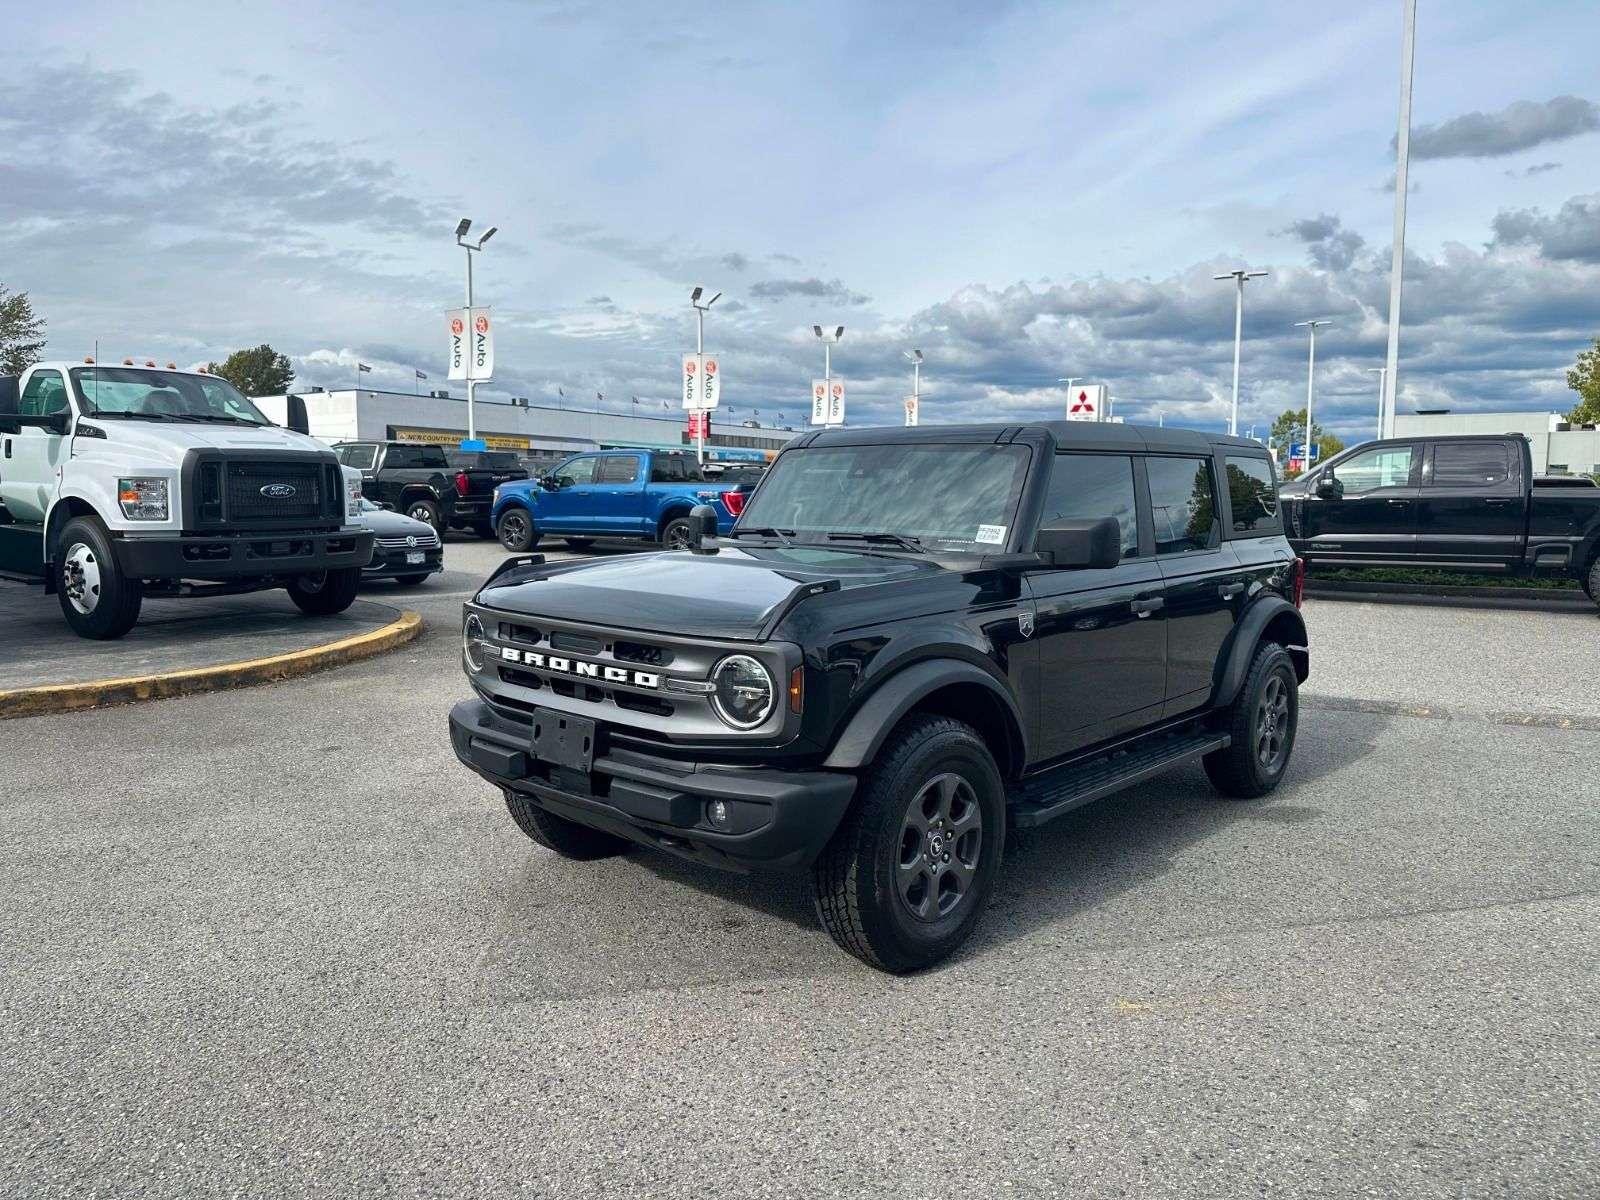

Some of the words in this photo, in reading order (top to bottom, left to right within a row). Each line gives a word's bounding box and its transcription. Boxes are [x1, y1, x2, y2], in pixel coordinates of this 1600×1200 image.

[453, 335, 461, 368] Auto
[477, 333, 486, 367] Auto
[502, 647, 659, 688] BRONCO
